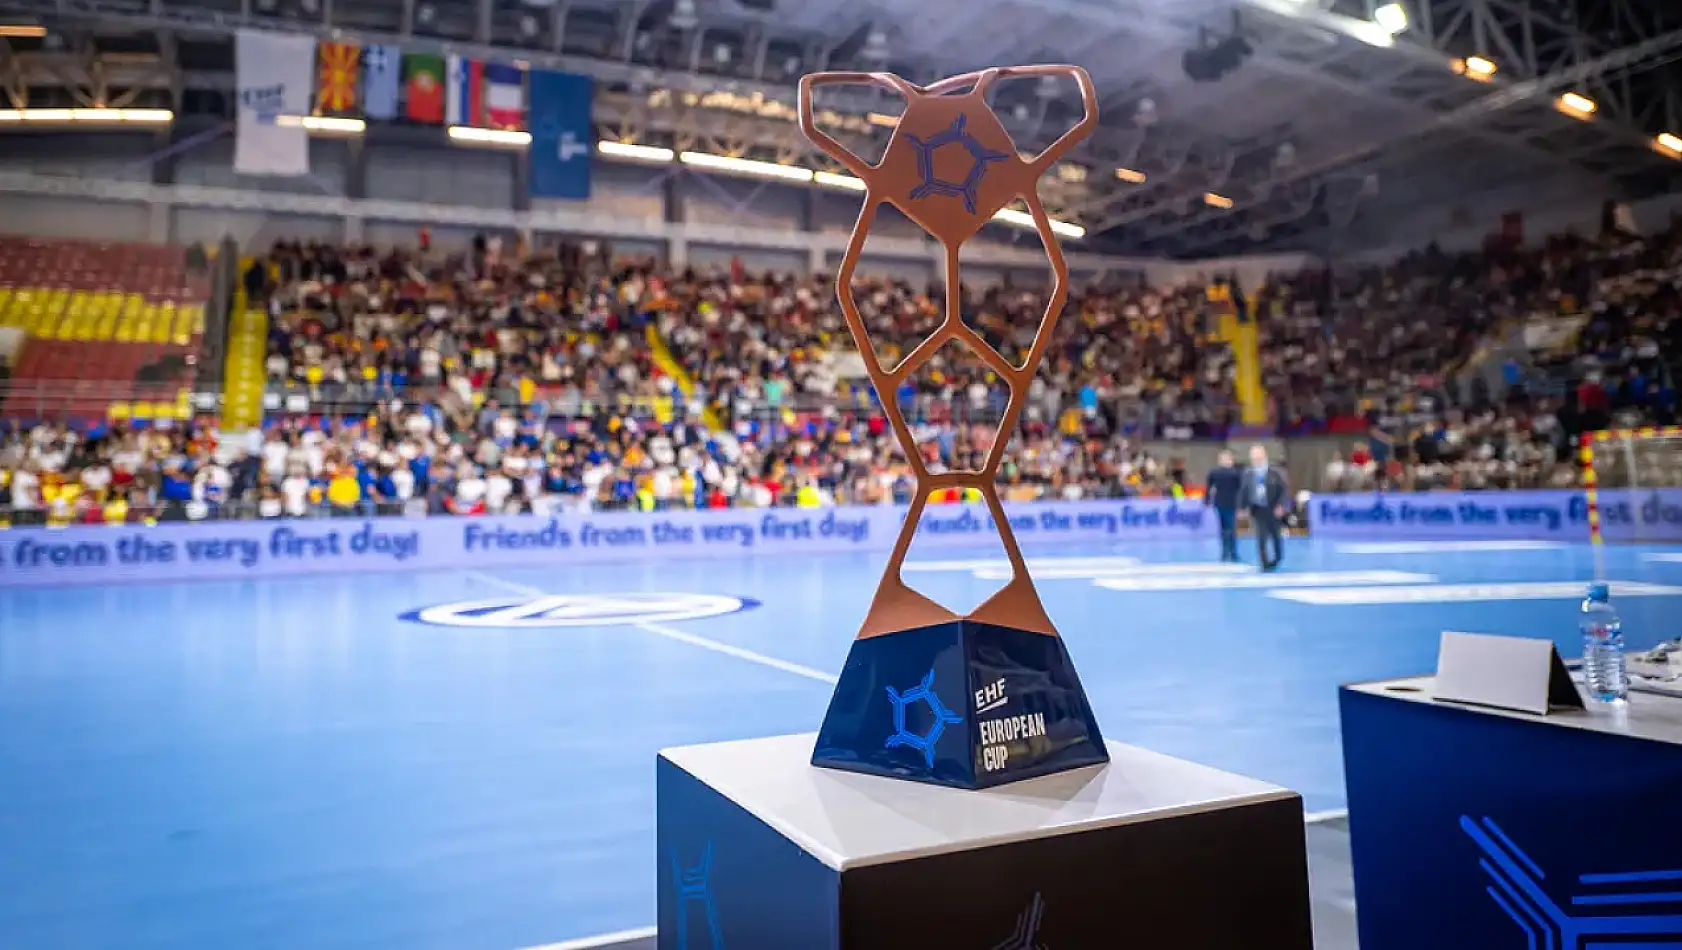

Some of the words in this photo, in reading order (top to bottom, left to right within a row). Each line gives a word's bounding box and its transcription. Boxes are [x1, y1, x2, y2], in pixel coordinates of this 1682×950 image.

[1568, 496, 1632, 524] fist
[15, 537, 107, 567] from
[116, 533, 175, 562] the
[187, 535, 260, 567] very
[269, 526, 342, 558] first
[350, 521, 418, 561] day!
[464, 519, 571, 551] Friends
[581, 521, 645, 547] from
[652, 518, 694, 544] the
[703, 520, 754, 547] very
[761, 513, 812, 540] first
[819, 510, 869, 542] day!
[975, 678, 1005, 708] EHF
[980, 712, 1046, 745] EUROPEAN
[983, 745, 1009, 772] CUP
